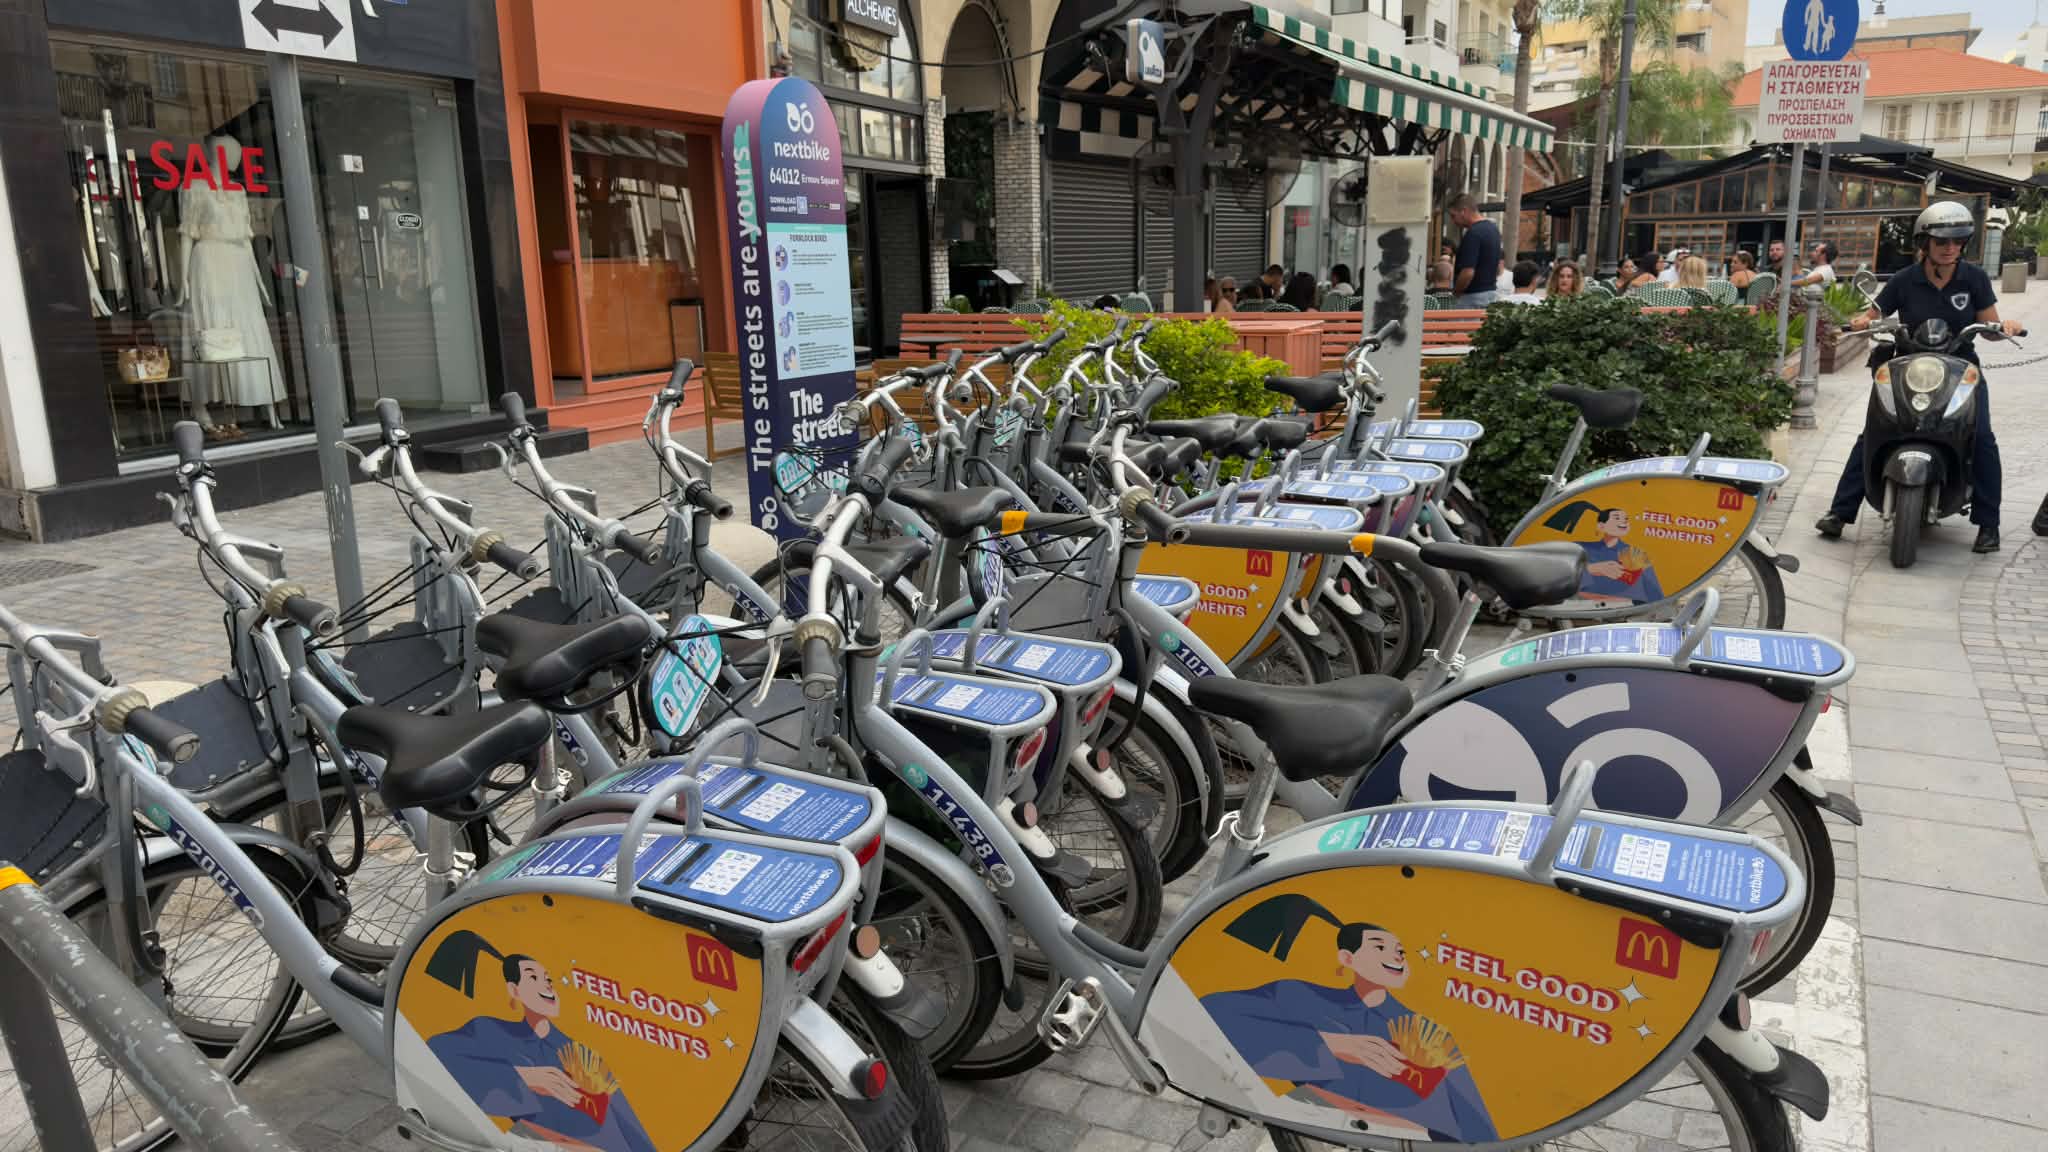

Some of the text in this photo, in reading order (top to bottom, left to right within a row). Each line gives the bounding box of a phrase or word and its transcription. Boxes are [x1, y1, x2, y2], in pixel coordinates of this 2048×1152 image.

[847, 0, 897, 26] ALCHEMIES
[1768, 64, 1862, 79] ΑΠΑΓΟΡΕΥΕΤΑΙ
[1767, 81, 1860, 95] Η ΣΤΑΘΜΕΥΣΗ
[1778, 98, 1846, 111] ΠΡΟΣΠΕΛΑΣΗ
[1767, 113, 1854, 126] ΠΥΡΟΣΒΕΣΤΙΚΩΝ
[1783, 127, 1837, 140] ΟΧΗΜΑΤΩΝ
[773, 141, 831, 161] nextbike
[150, 140, 270, 193] SALE
[769, 167, 800, 185] 64012
[820, 176, 841, 187] Square
[733, 146, 773, 472] The streets are yours
[789, 388, 824, 418] The
[1642, 511, 1717, 530] FEEL GOOD
[1644, 527, 1714, 545] MOMENTS
[1204, 584, 1248, 600] GOOD
[1193, 600, 1246, 617] MENTS
[926, 787, 995, 860] 11438
[788, 879, 826, 916] nextbike
[1749, 868, 1764, 904] nextbike
[1437, 943, 1618, 1013] FEEL GOOD
[572, 968, 706, 1028] FEEL GOOD
[1444, 978, 1611, 1045] MOMENTS
[585, 1003, 710, 1060] MOMENTS
